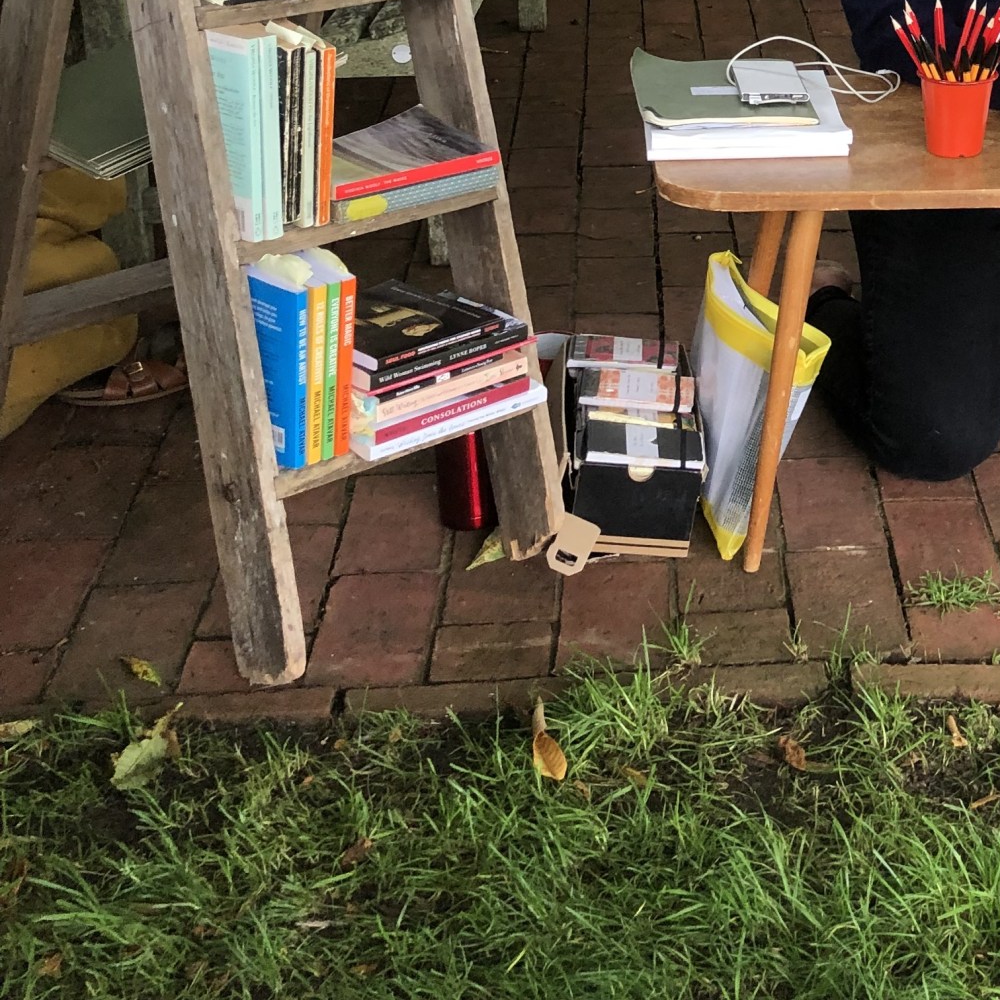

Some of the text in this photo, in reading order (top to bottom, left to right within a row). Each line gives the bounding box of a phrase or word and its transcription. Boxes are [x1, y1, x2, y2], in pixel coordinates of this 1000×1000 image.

[299, 327, 306, 337] TO
[344, 295, 353, 346] BETTER MAGIC
[299, 338, 306, 349] BE
[329, 297, 340, 377] EVERYONE IS CREATIVE
[299, 350, 306, 360] AN
[315, 346, 324, 384] CREATIVITY
[379, 374, 392, 383] Wild
[414, 360, 441, 372] Swimming
[421, 397, 487, 425] CONSOLATIONS
[312, 424, 320, 450] ATAVAR
